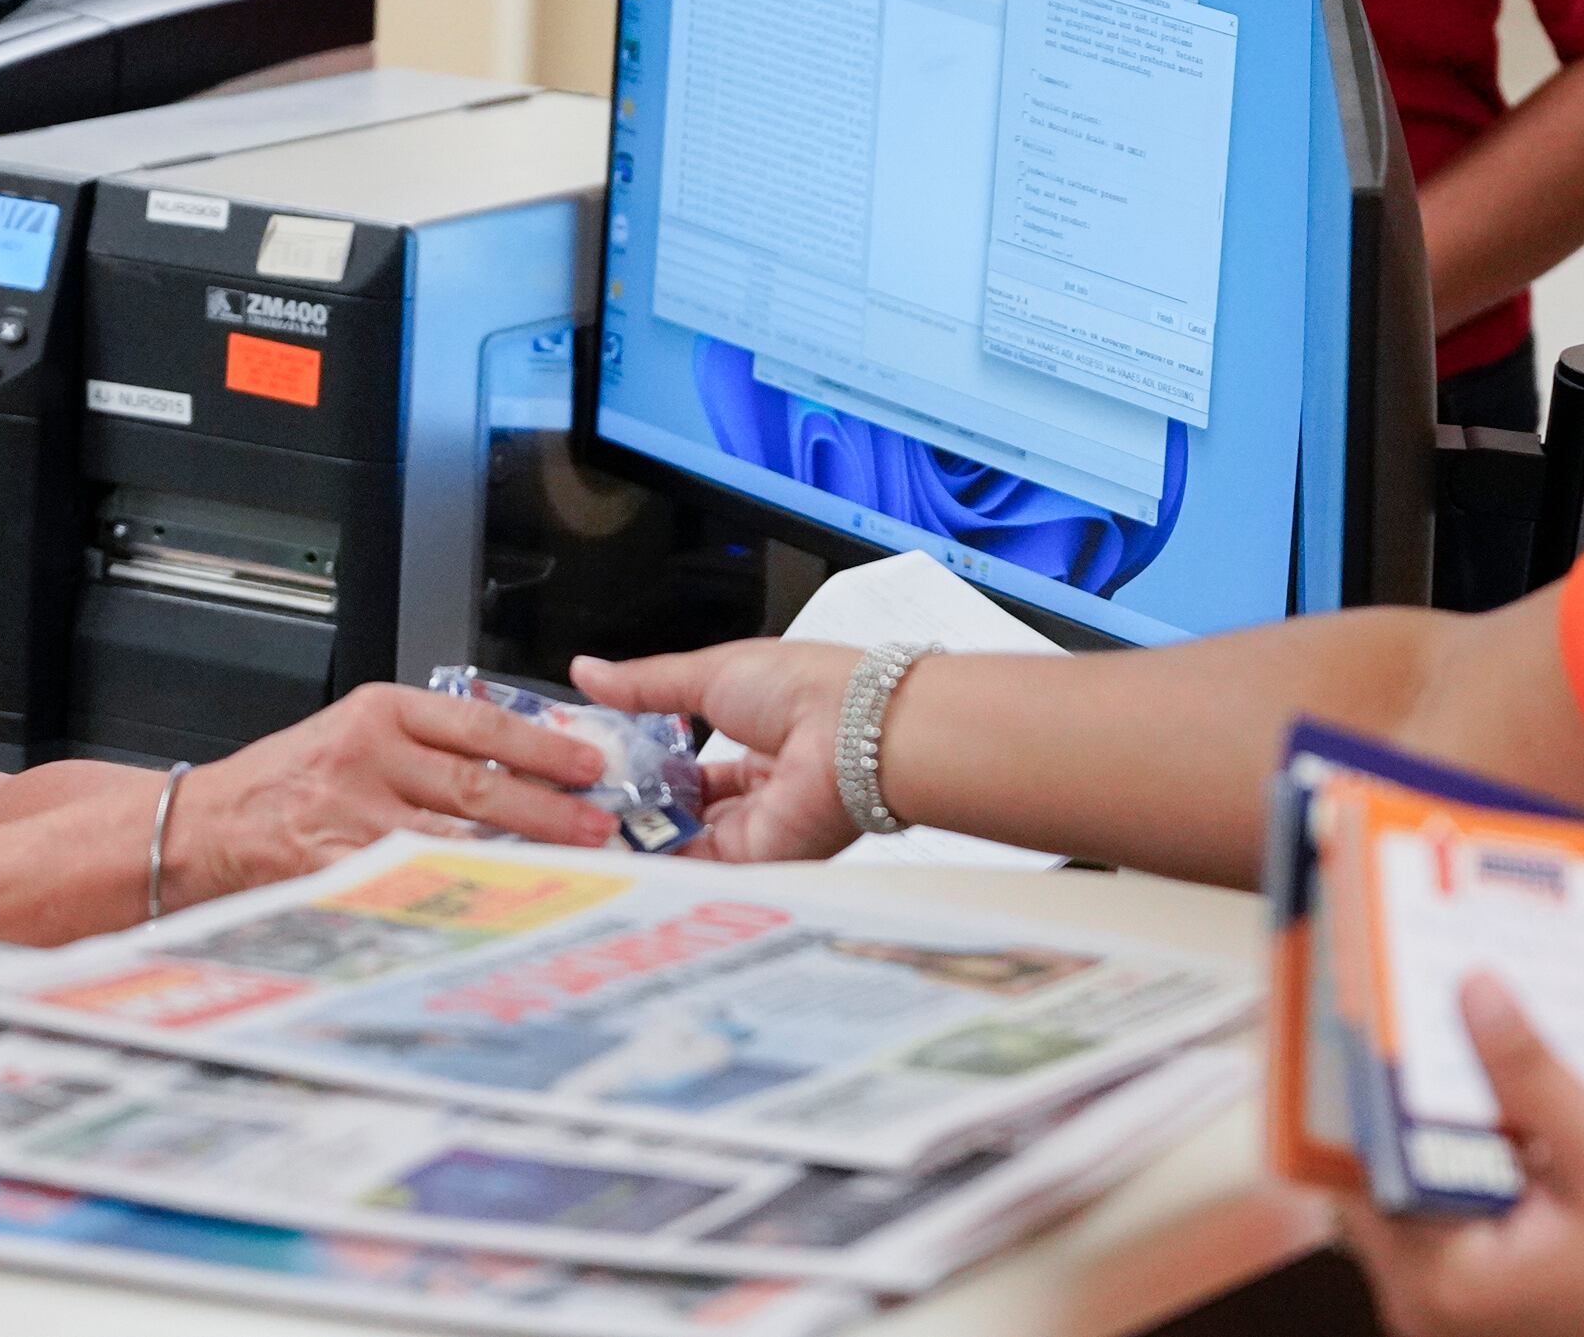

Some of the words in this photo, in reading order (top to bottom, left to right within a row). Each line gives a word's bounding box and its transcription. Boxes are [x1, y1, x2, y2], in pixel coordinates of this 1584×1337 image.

[246, 293, 328, 325] ZM400
[1156, 312, 1174, 325] Finish
[1188, 322, 1207, 336] Cancel
